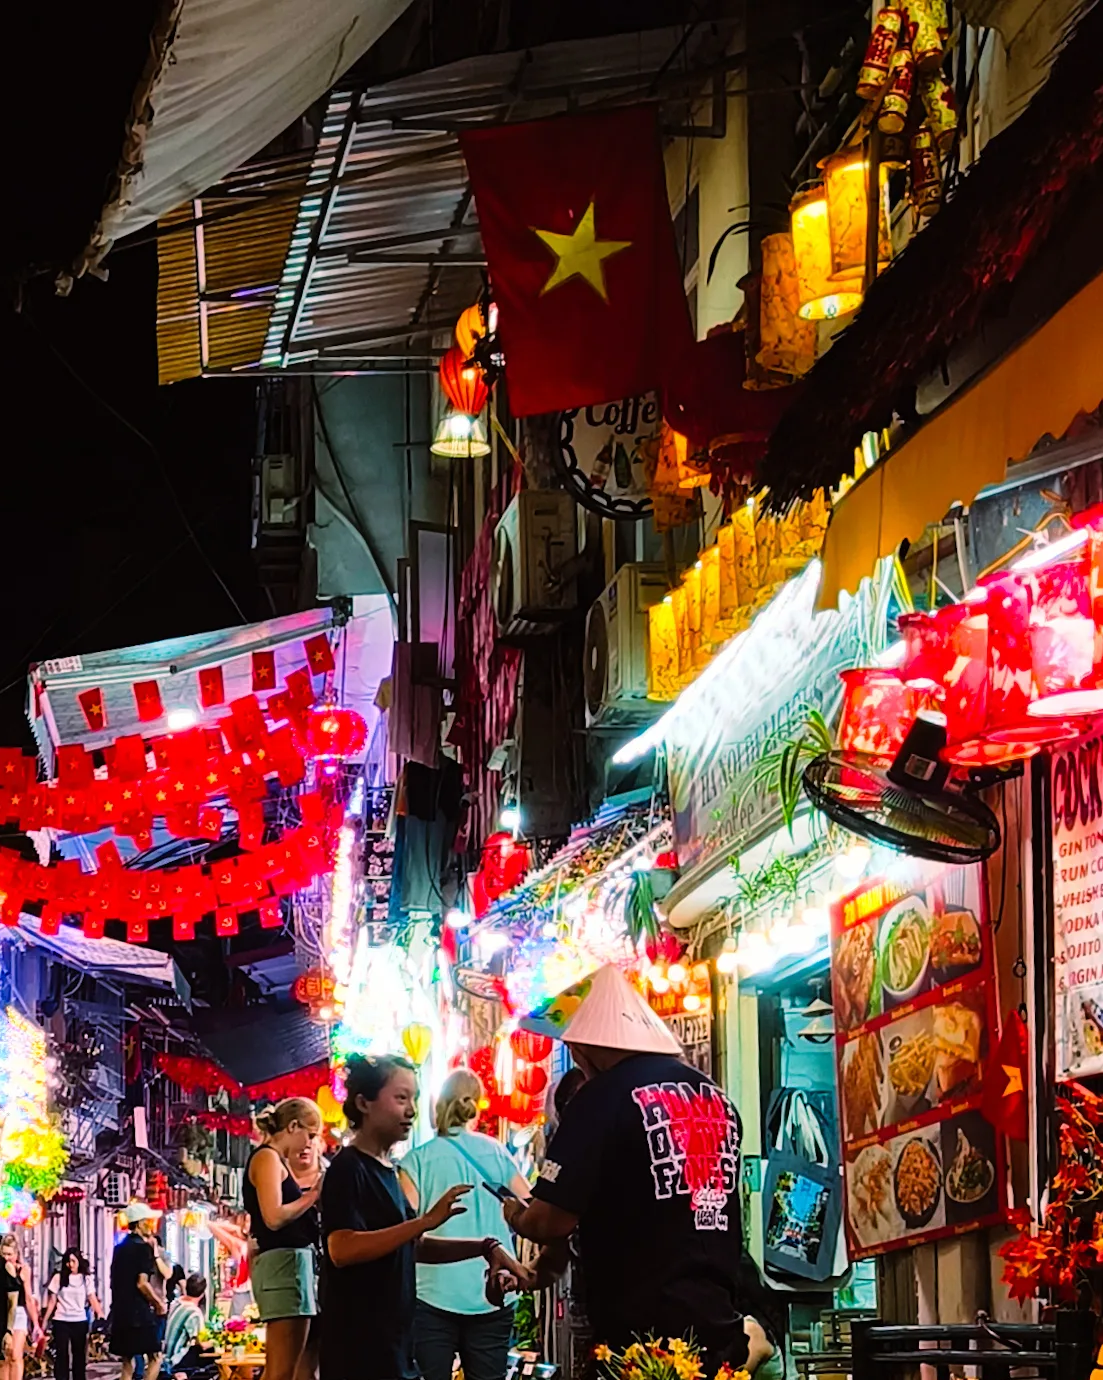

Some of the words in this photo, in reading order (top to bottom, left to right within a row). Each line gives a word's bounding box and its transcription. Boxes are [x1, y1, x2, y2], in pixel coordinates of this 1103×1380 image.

[1059, 839, 1083, 858] GIN
[1065, 911, 1100, 934] ODKA
[1066, 938, 1101, 960] OJITO
[631, 1082, 739, 1131] HOME
[647, 1120, 692, 1163] OF
